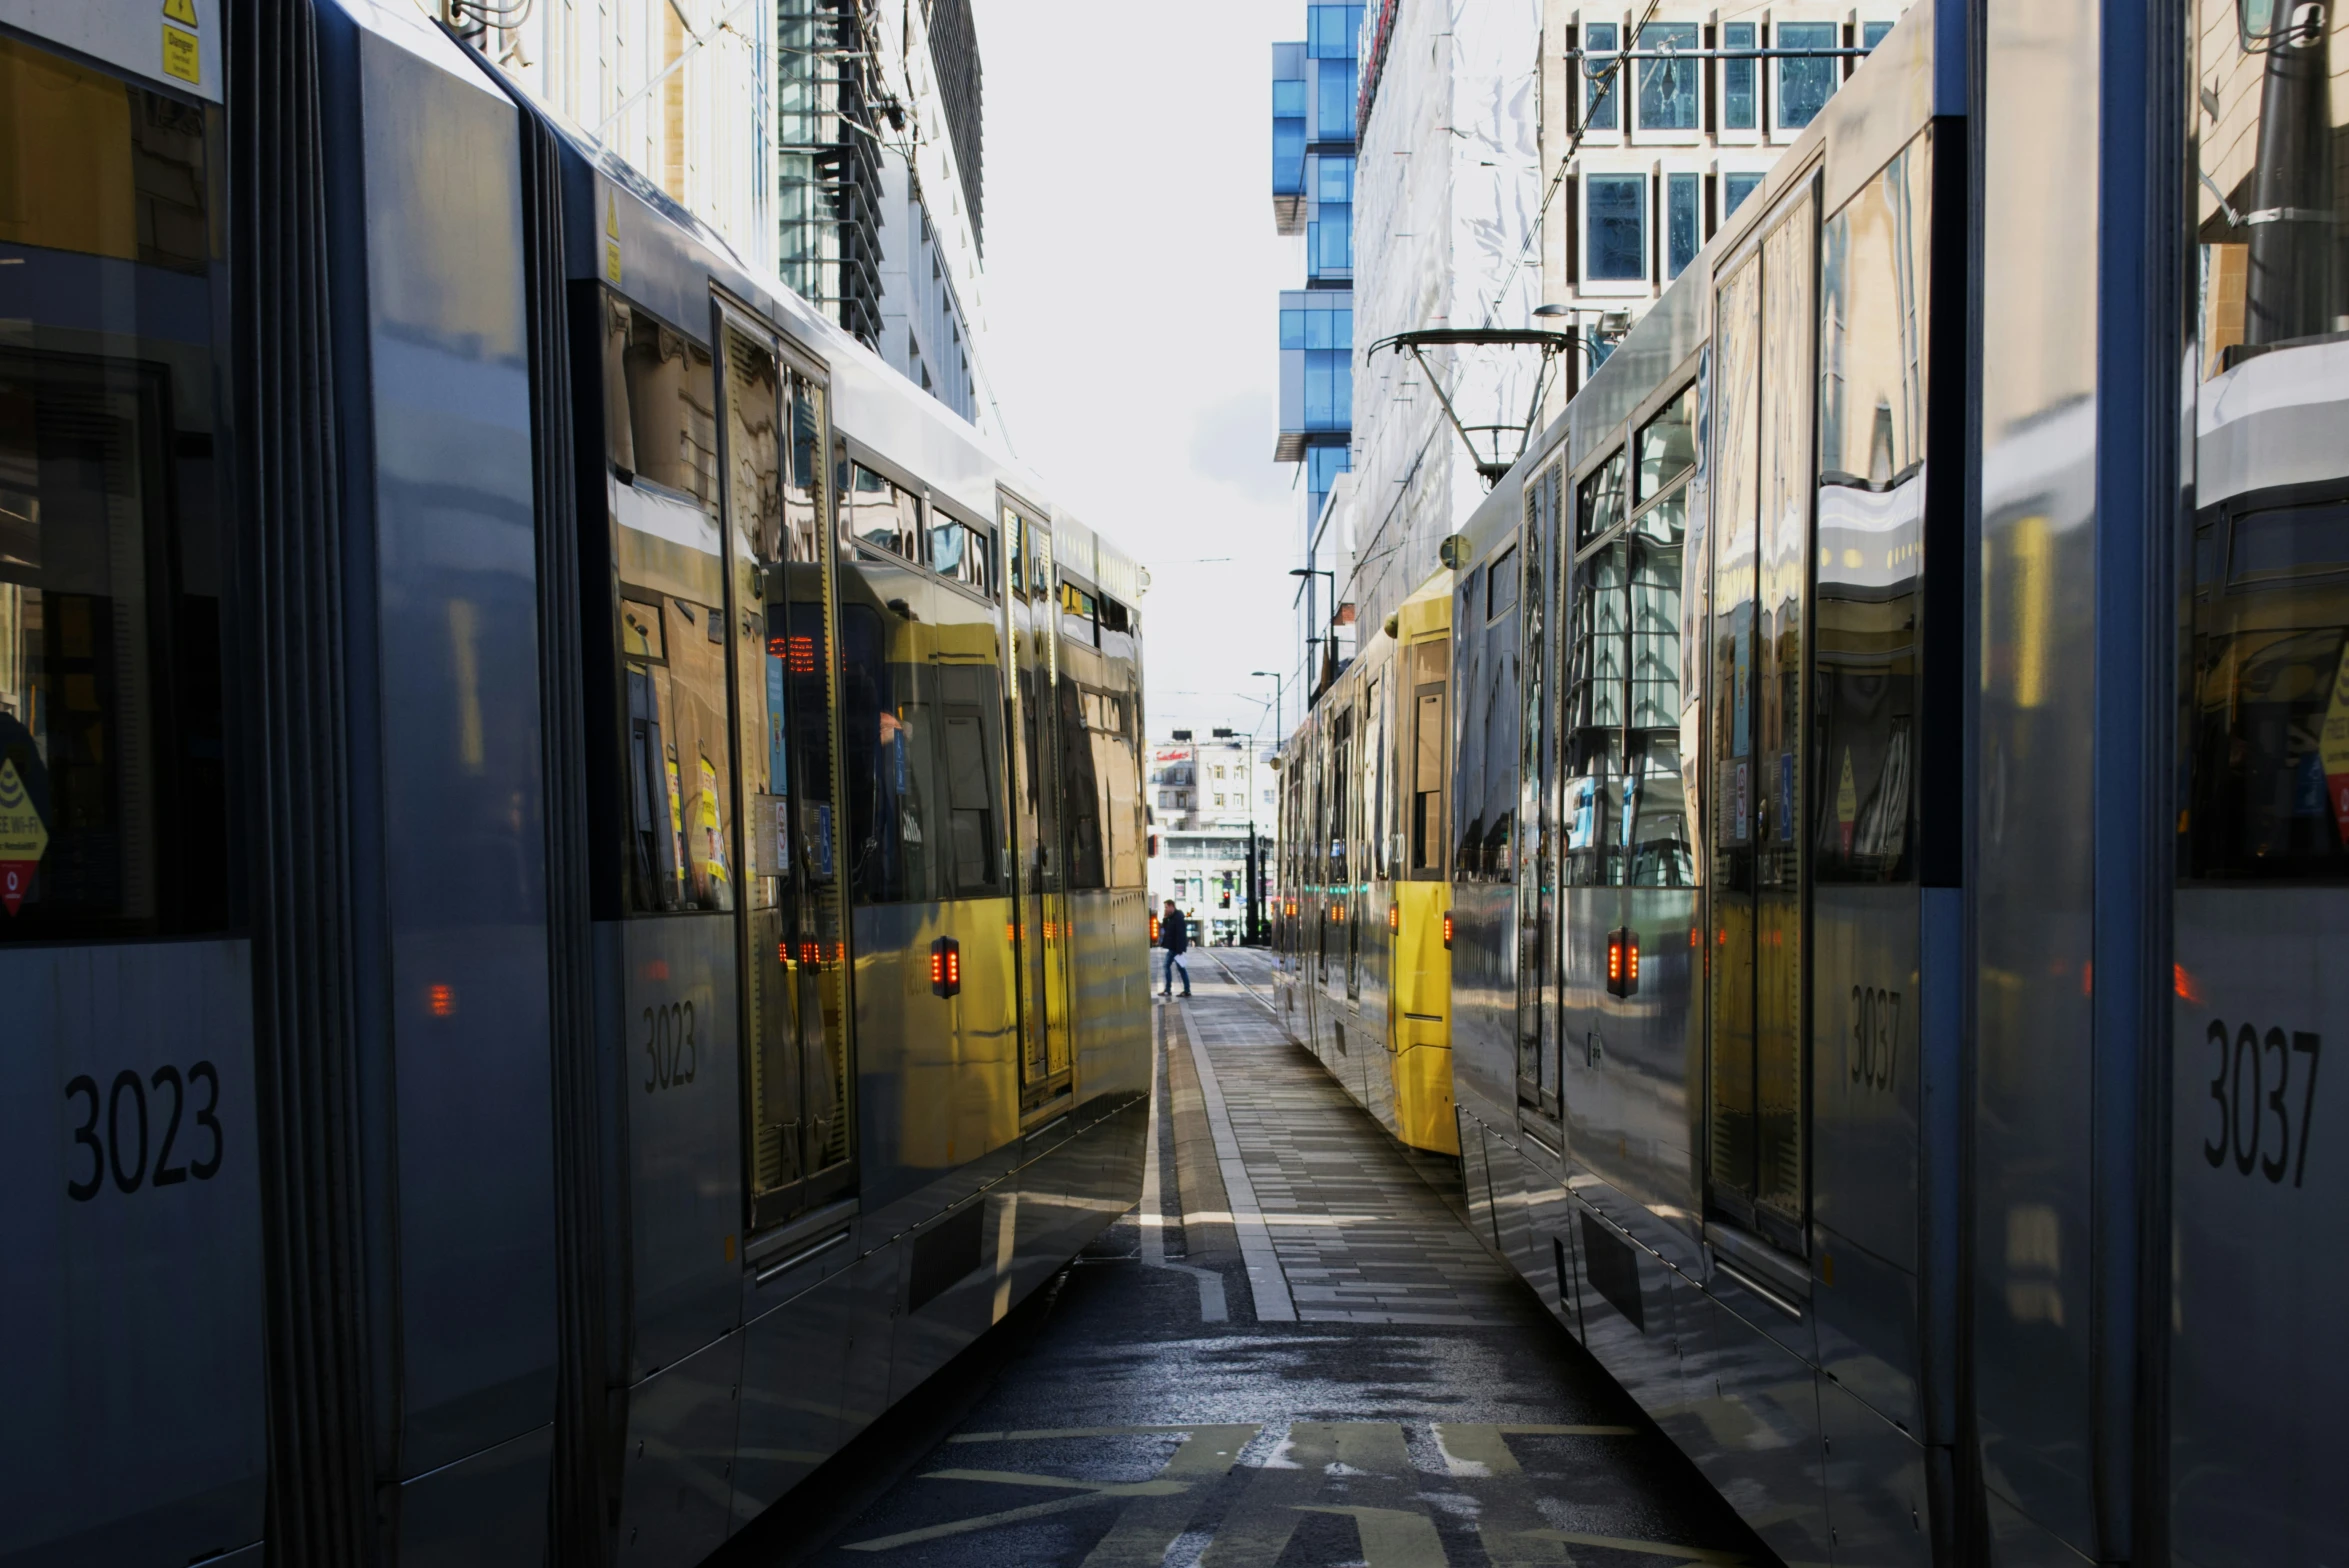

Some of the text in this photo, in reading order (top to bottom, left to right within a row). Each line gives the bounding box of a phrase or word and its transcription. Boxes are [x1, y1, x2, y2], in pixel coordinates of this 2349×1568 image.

[168, 32, 194, 54] Danger
[644, 1001, 696, 1093] 3023
[1852, 985, 1901, 1092] 3037
[65, 1060, 222, 1201] 3023
[2204, 1019, 2320, 1188] 3037
